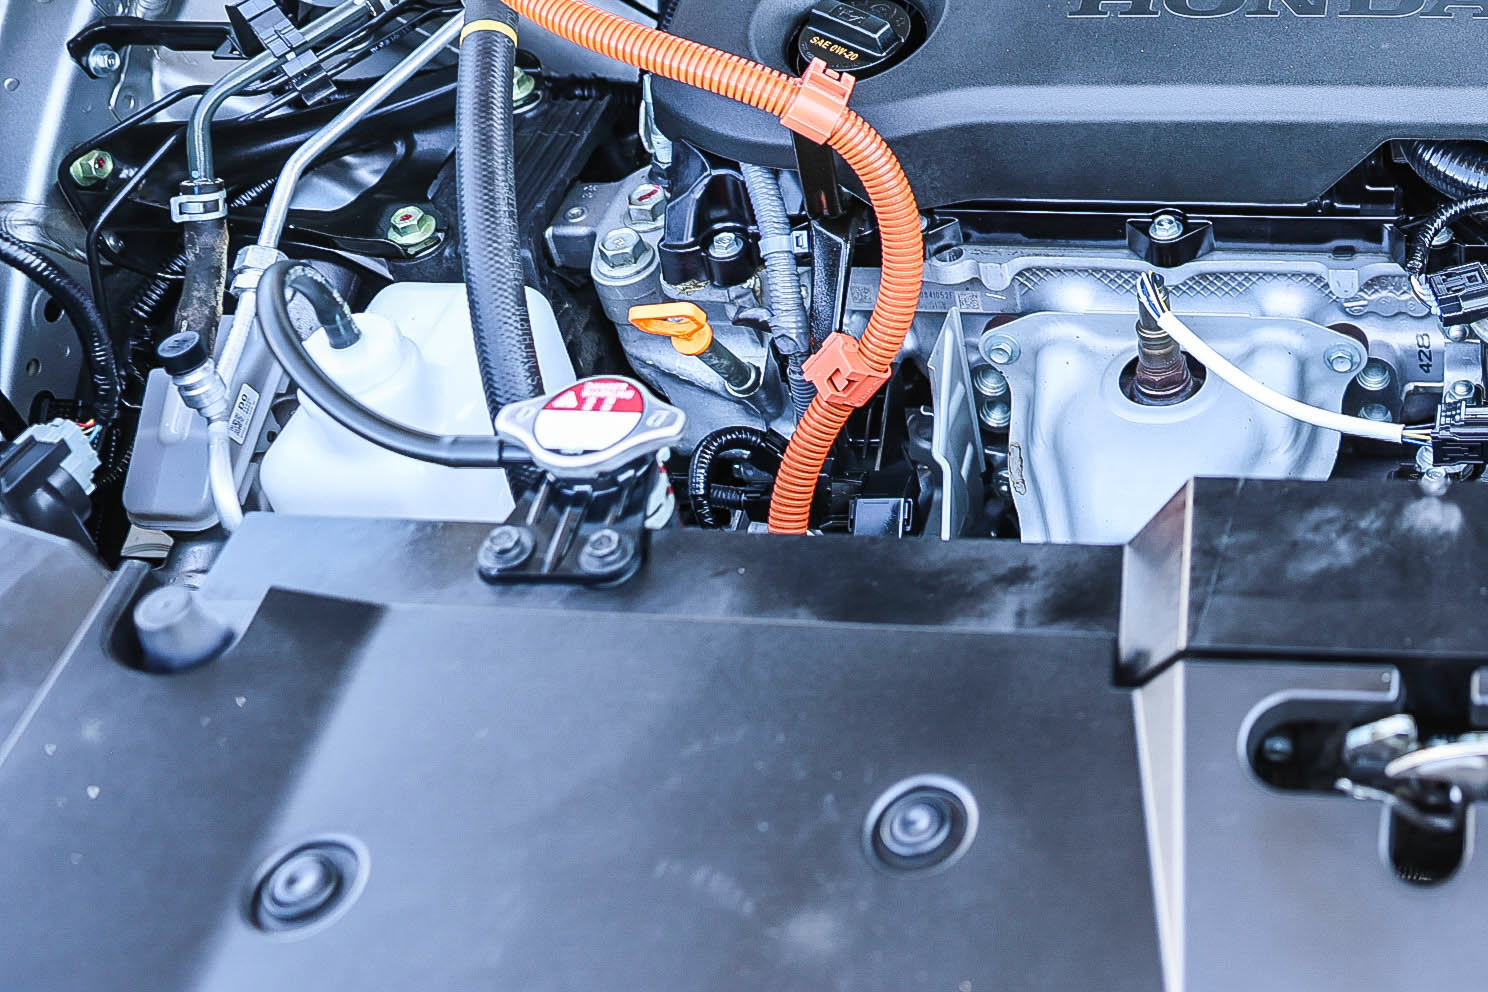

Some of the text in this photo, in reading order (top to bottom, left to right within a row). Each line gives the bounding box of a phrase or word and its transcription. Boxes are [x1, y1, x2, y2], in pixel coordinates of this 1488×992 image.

[810, 36, 831, 50] SAE
[830, 44, 859, 62] 0W-20
[1415, 332, 1432, 373] 428
